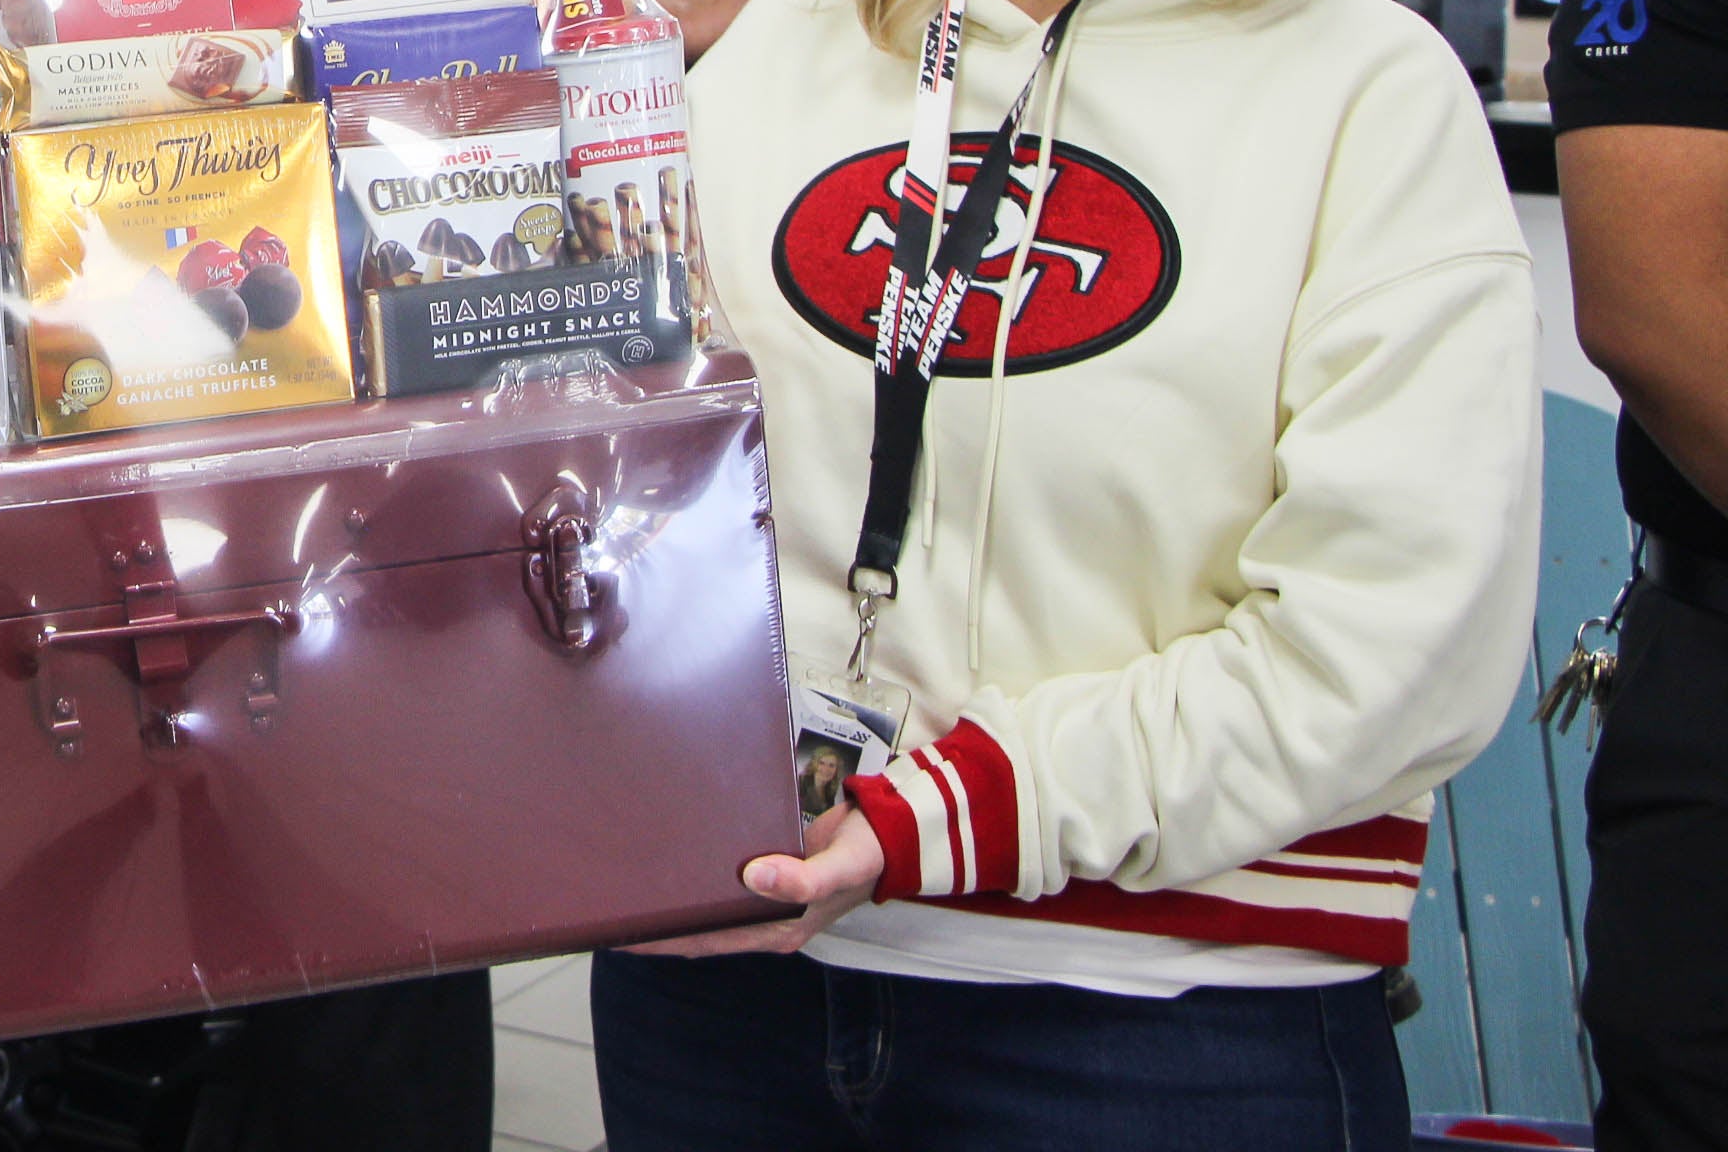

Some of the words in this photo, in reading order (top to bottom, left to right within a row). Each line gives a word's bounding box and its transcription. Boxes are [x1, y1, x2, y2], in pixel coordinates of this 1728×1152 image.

[46, 49, 147, 74] GODIVA
[921, 10, 943, 92] ENSKE
[940, 11, 963, 81] TEAM
[1585, 45, 1629, 57] CREEK
[58, 82, 140, 96] MASTERPIECES
[578, 143, 640, 161] Chocolate
[65, 142, 160, 208] Yves
[185, 191, 225, 201] FRENCH
[430, 278, 640, 326] HAMMOND'S
[875, 264, 904, 375] PENSKE
[905, 268, 944, 352] TEAM
[433, 321, 552, 349] MIDNIGHT
[565, 310, 641, 332] SNACK
[917, 269, 968, 382] PENSKE
[72, 377, 104, 386] COCOA
[122, 368, 168, 387] DARK
[173, 358, 268, 380] CHOCOLATE
[117, 383, 195, 406] GANACHE
[202, 375, 277, 395] TRUFFLES
